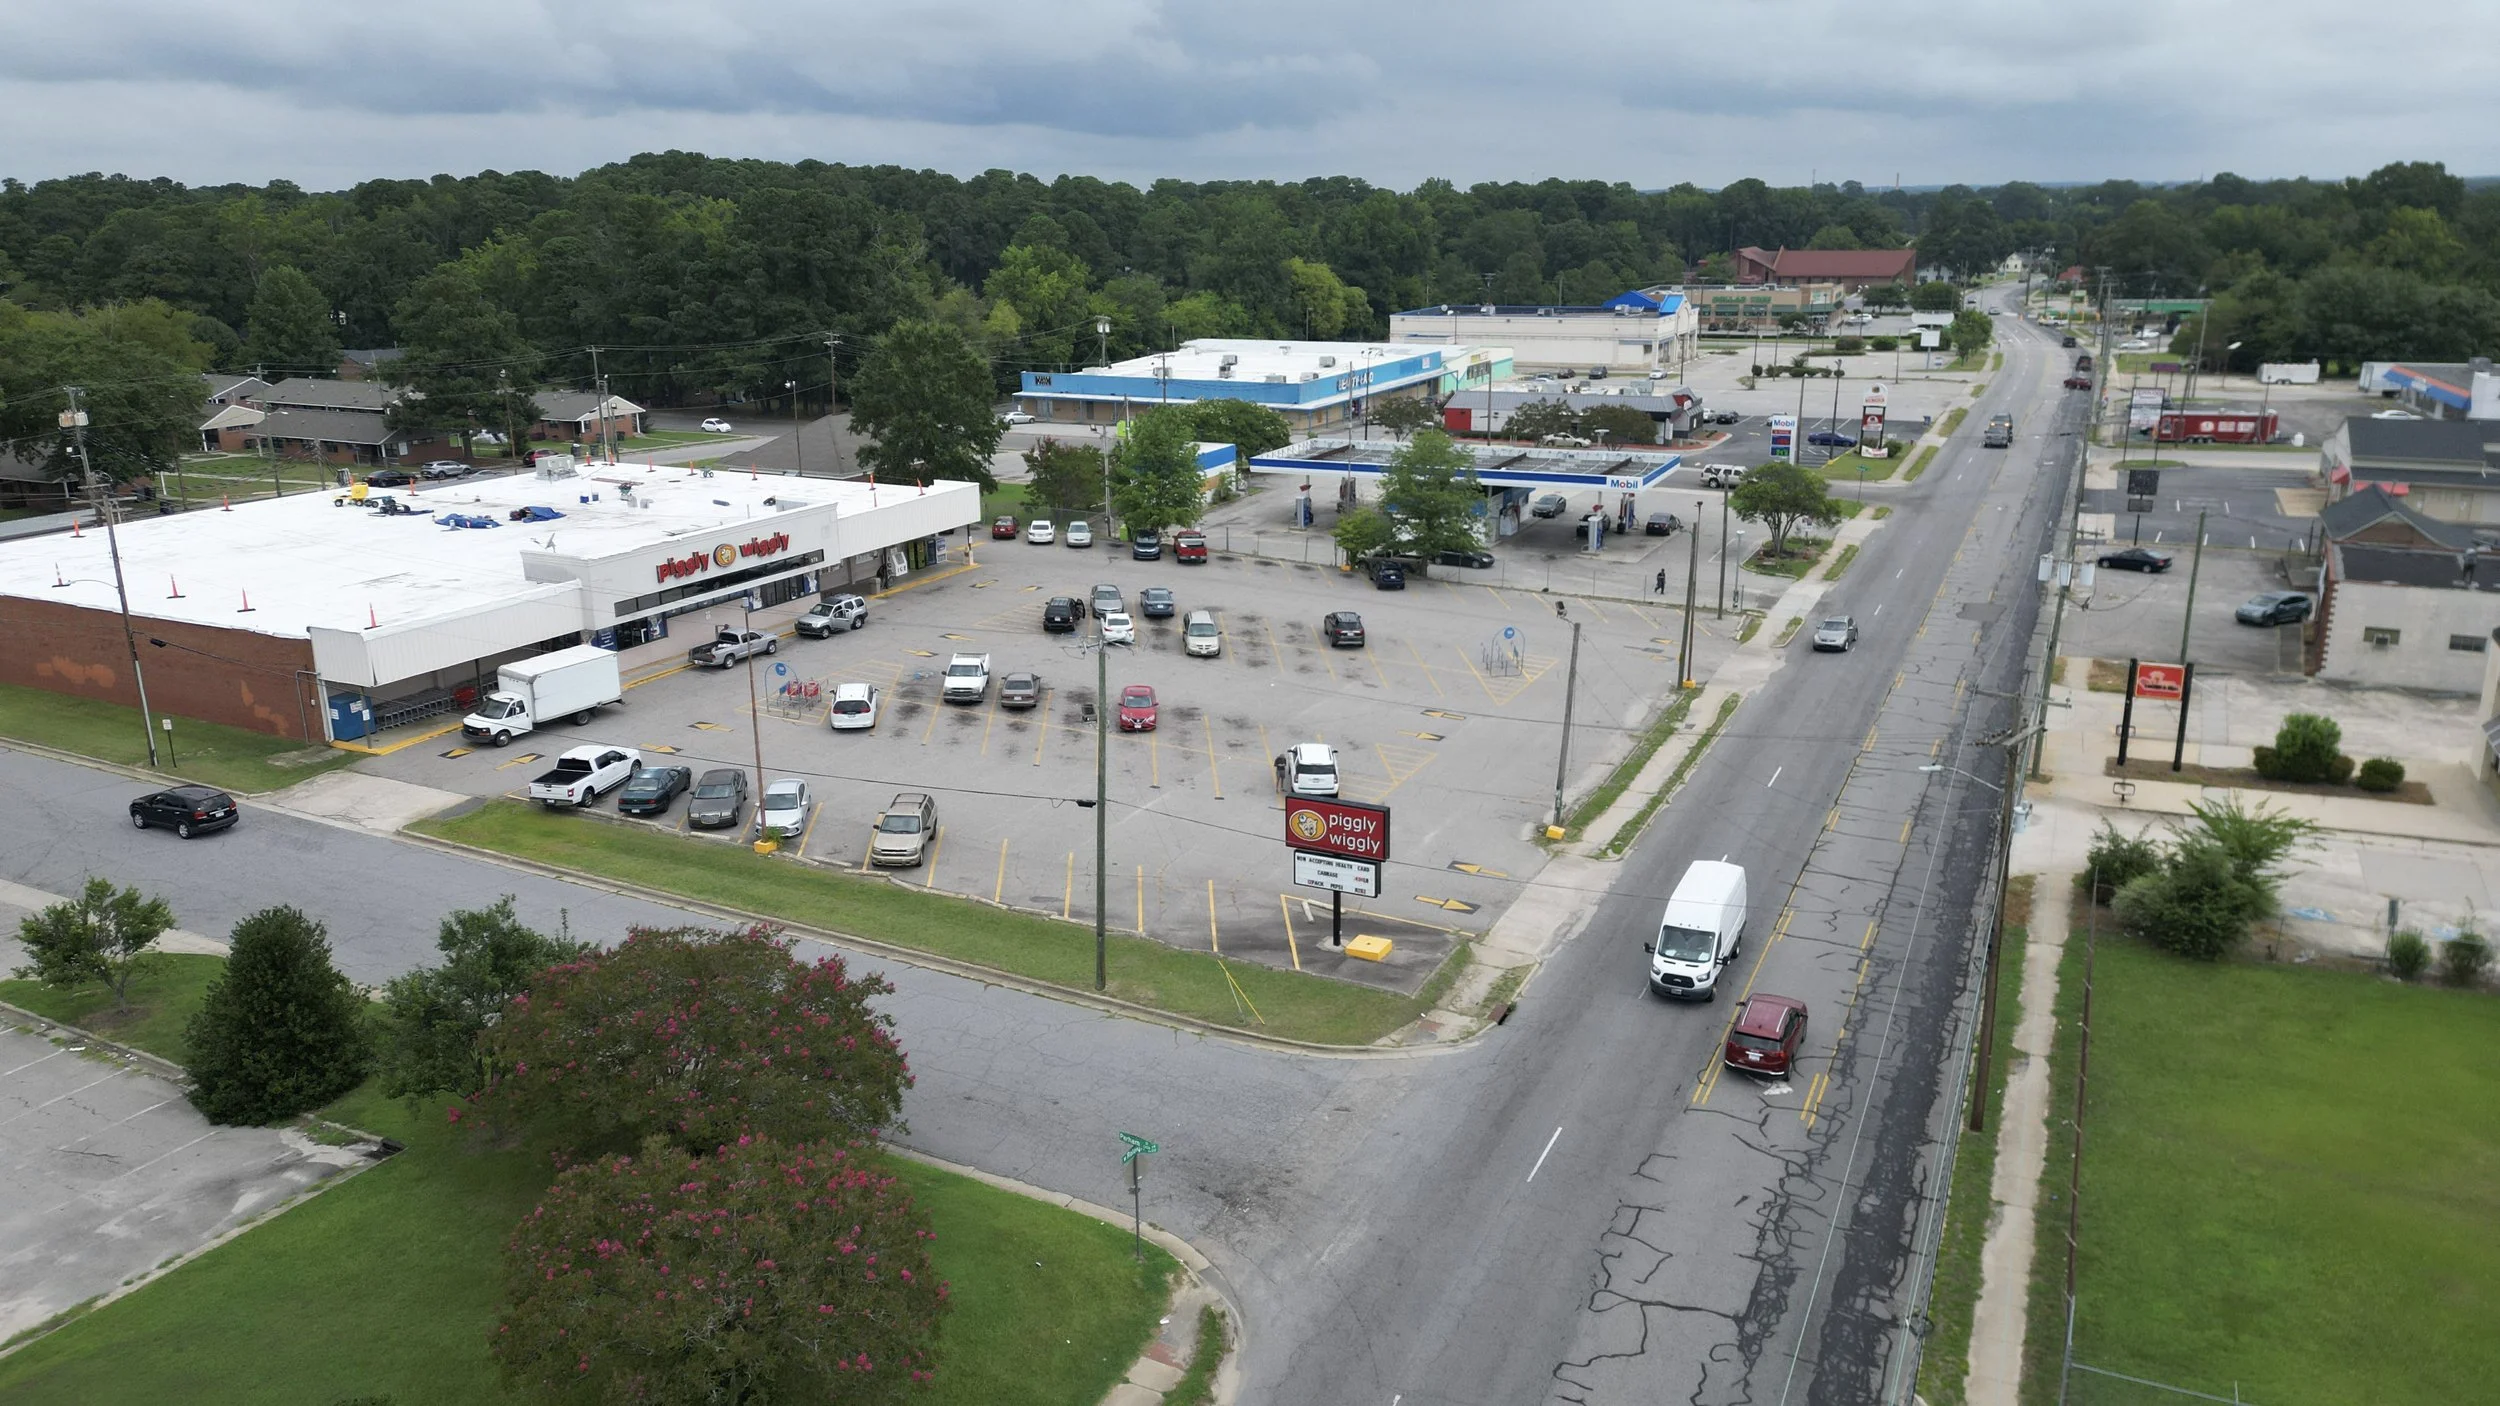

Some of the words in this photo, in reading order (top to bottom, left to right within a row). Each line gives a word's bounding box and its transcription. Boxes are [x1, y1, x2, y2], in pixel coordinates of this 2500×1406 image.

[1773, 419, 1795, 427] Mobil
[1610, 479, 1638, 489] Mobil
[656, 551, 709, 583] piggly
[739, 532, 789, 557] wiggly
[897, 565, 907, 573] ICE
[1329, 813, 1376, 834] piggly
[1329, 833, 1380, 854] wiggly
[1335, 862, 1353, 870] HEALTH
